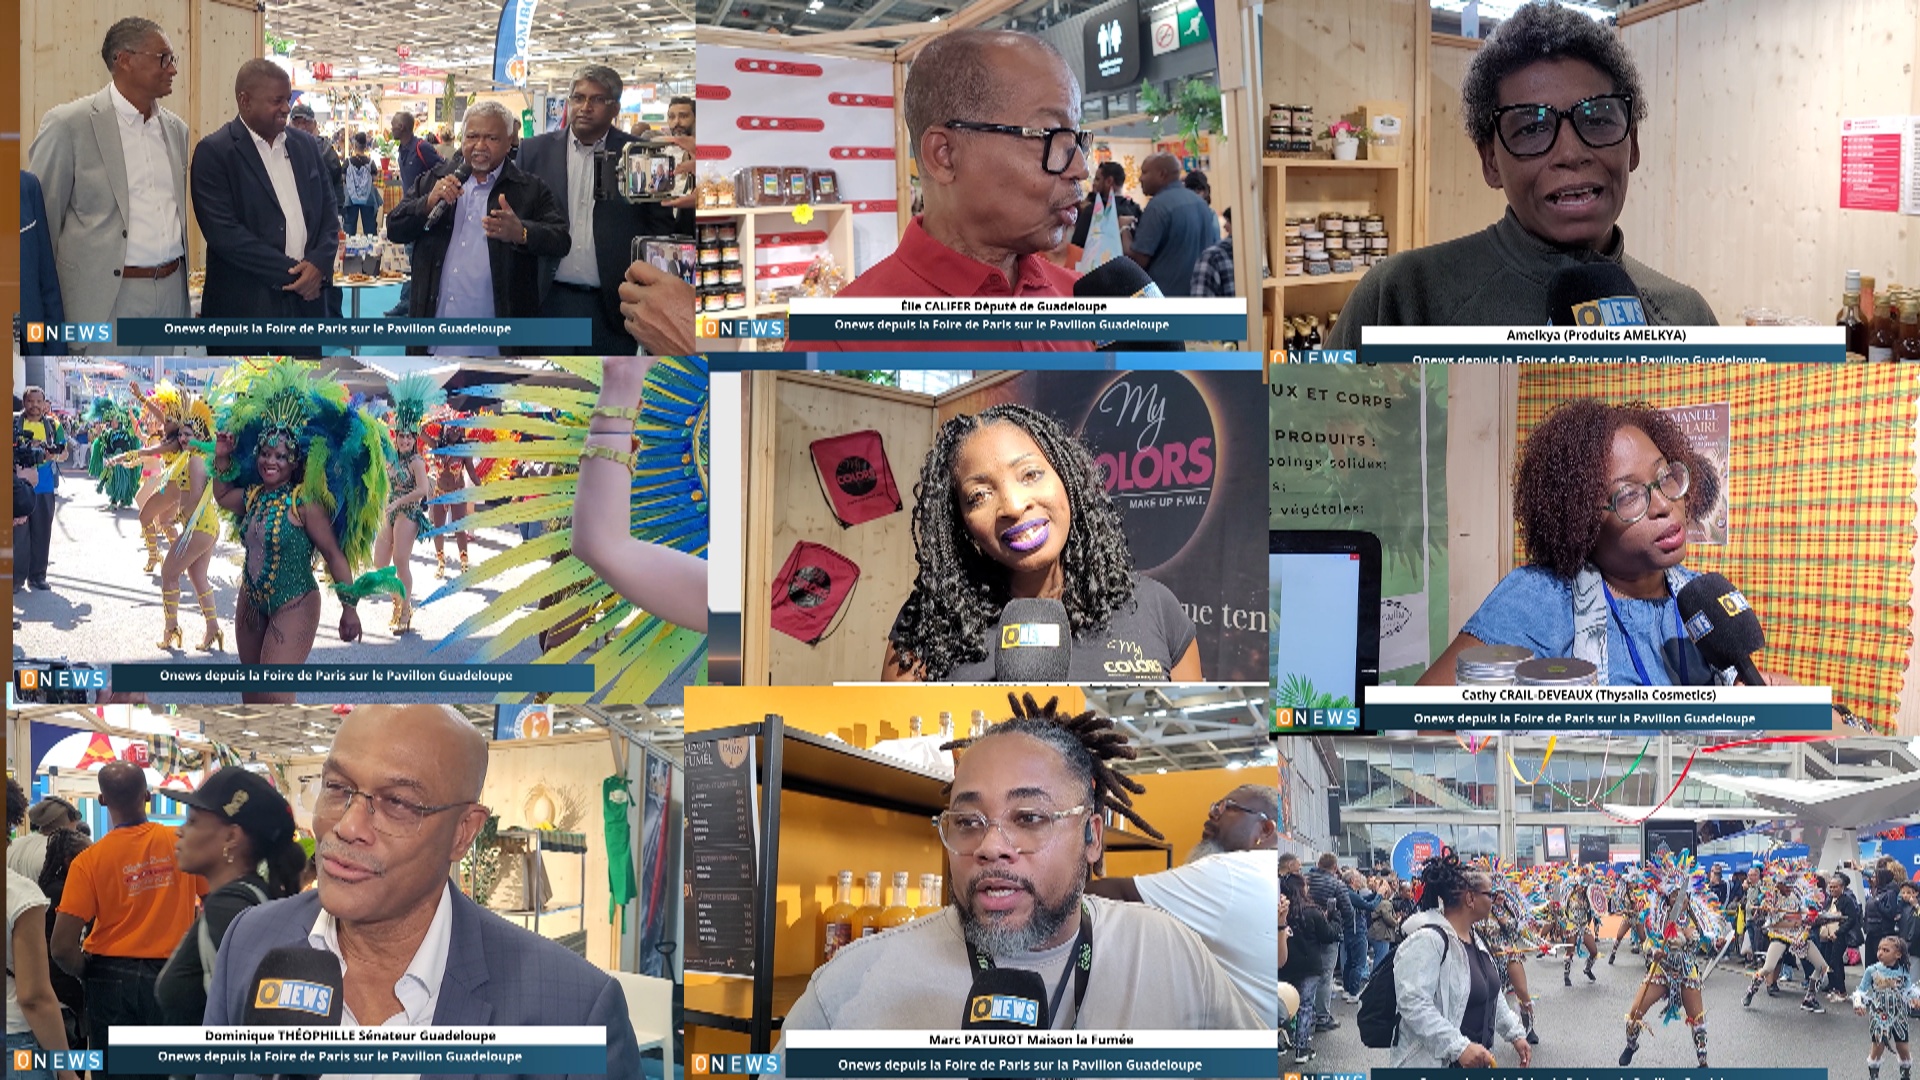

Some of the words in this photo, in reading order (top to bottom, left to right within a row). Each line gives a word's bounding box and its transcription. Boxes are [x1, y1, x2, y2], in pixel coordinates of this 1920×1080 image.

[1577, 300, 1643, 326] ONEWS
[1307, 387, 1329, 401] ET
[1336, 391, 1392, 409] CORPS
[1100, 381, 1166, 453] My
[1663, 409, 1719, 423] MANUEL
[1275, 429, 1366, 447] PRODUITS
[1093, 437, 1213, 492] OLORS
[1129, 499, 1156, 509] MAKE
[1159, 498, 1173, 507] UP
[1181, 602, 1213, 626] ue
[259, 981, 329, 1011] ONEWS
[973, 998, 1035, 1021] ONEWS
